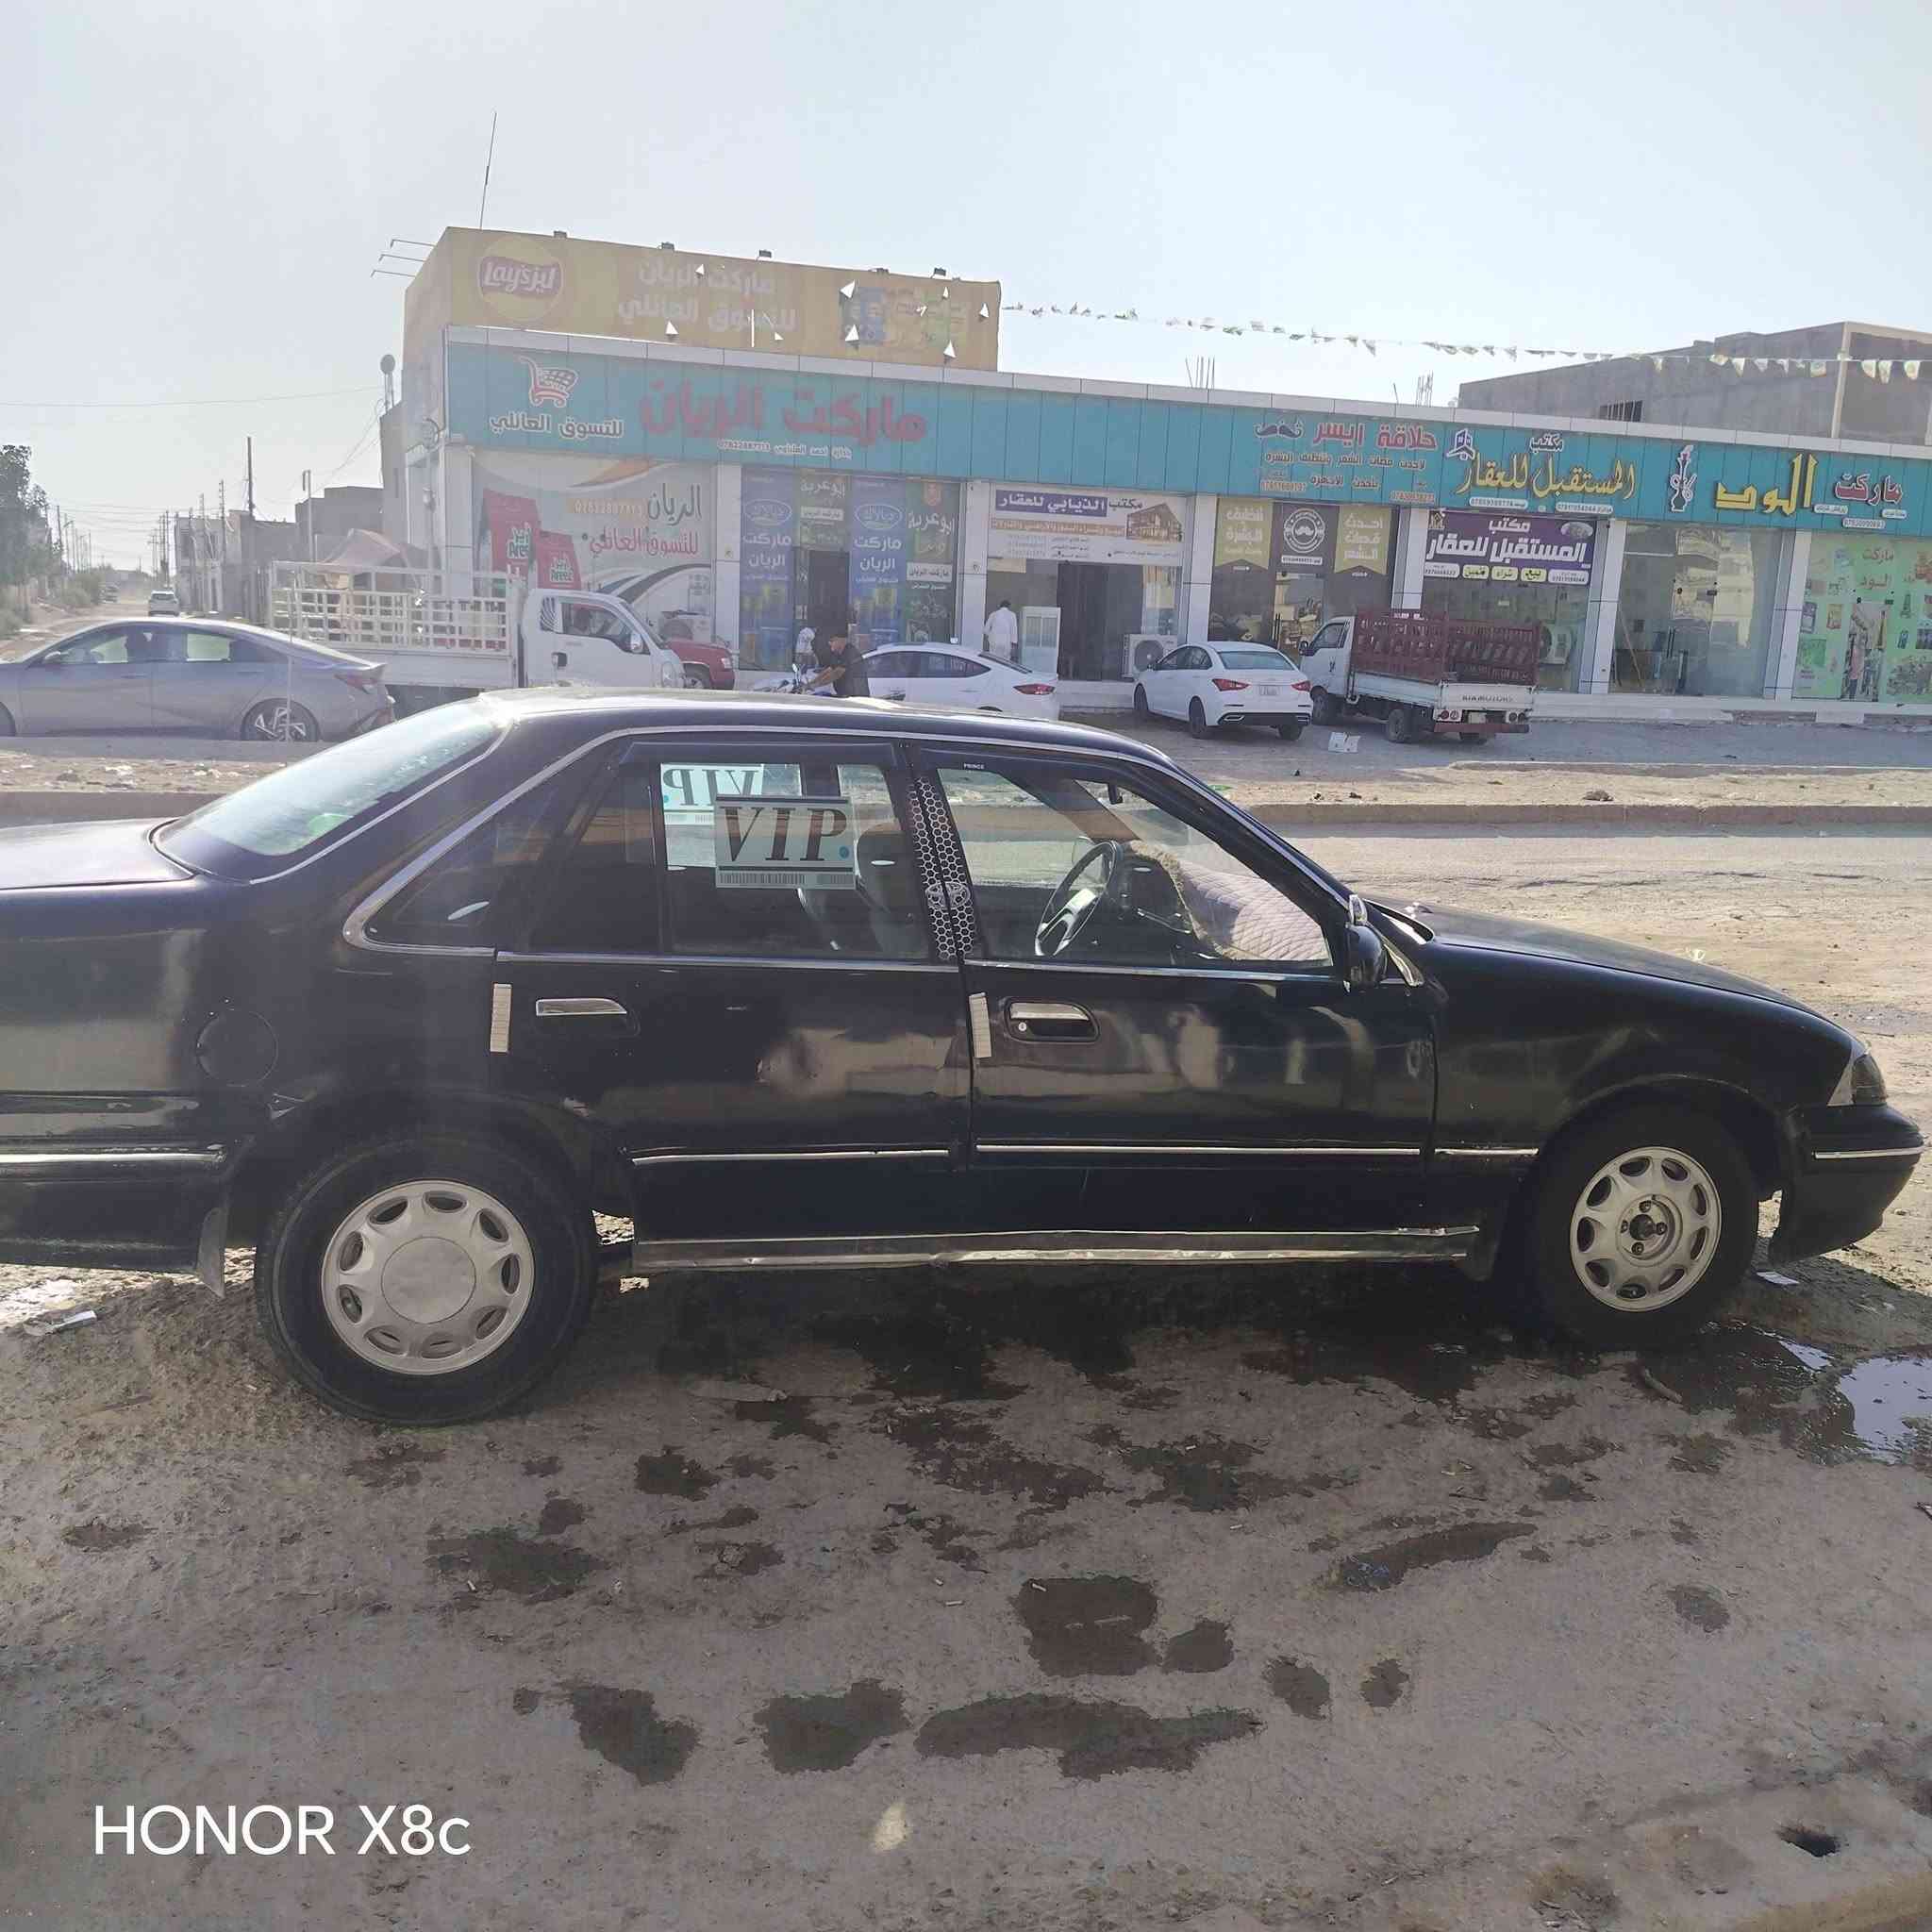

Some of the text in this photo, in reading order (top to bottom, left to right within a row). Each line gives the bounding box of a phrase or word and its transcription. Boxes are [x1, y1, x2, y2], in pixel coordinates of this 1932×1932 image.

[489, 410, 625, 440] للتسوق العائلي
[639, 377, 927, 446] ماركت الريان
[1376, 423, 1439, 450] حلاقة
[1529, 433, 1564, 453] مكتب
[1457, 453, 1529, 494] للعقار
[1532, 454, 1636, 499] المستقبل
[647, 483, 703, 525] الريان
[1000, 492, 1044, 508] للعقار
[1836, 471, 1904, 507] ماركت
[743, 531, 791, 548] ماركت
[1489, 517, 1532, 534] مكتب
[591, 528, 698, 558] للتسوق العائلي
[854, 536, 902, 552] ماركت
[1426, 533, 1587, 563] المستقبل للعقار
[748, 552, 785, 570] الريان
[859, 555, 895, 574] الريان
[720, 806, 847, 862] VIP
